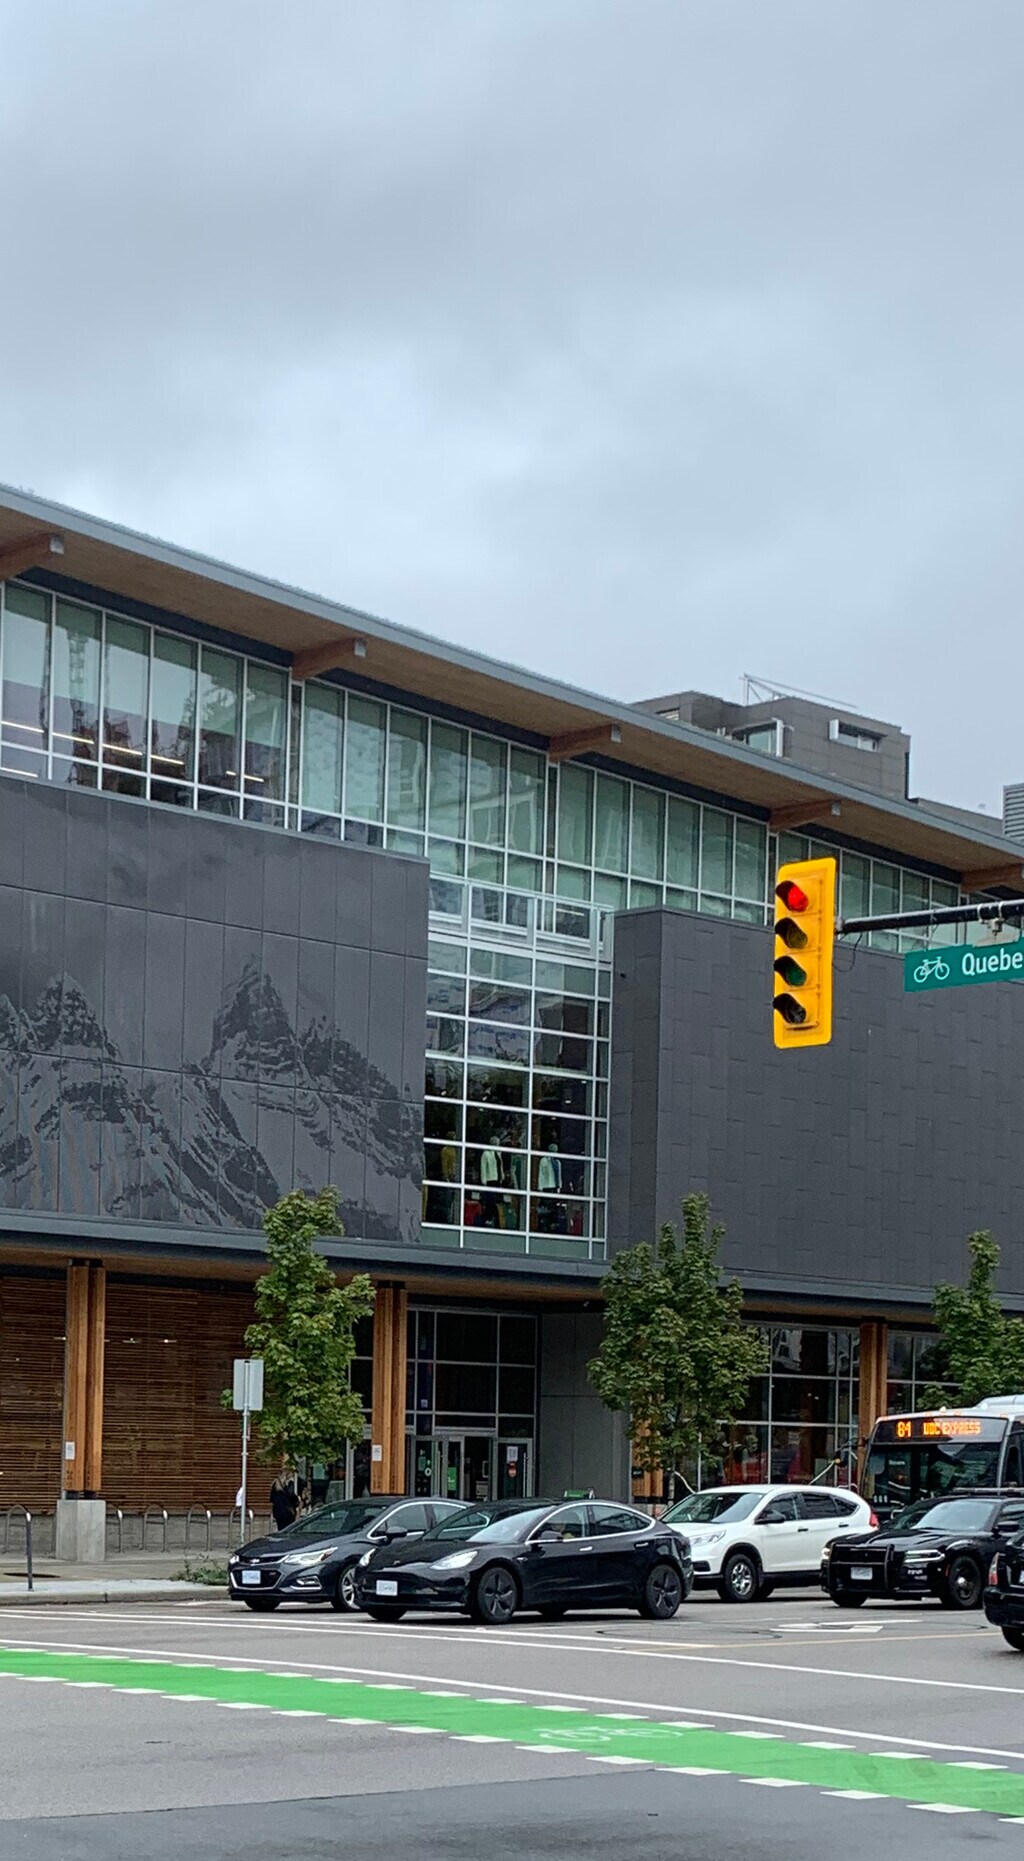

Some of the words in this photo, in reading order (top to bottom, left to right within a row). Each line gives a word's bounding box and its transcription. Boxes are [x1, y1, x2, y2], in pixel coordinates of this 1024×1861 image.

[961, 947, 1024, 977] Quebe
[923, 1421, 941, 1436] UBC
[942, 1421, 981, 1436] EXPRESS
